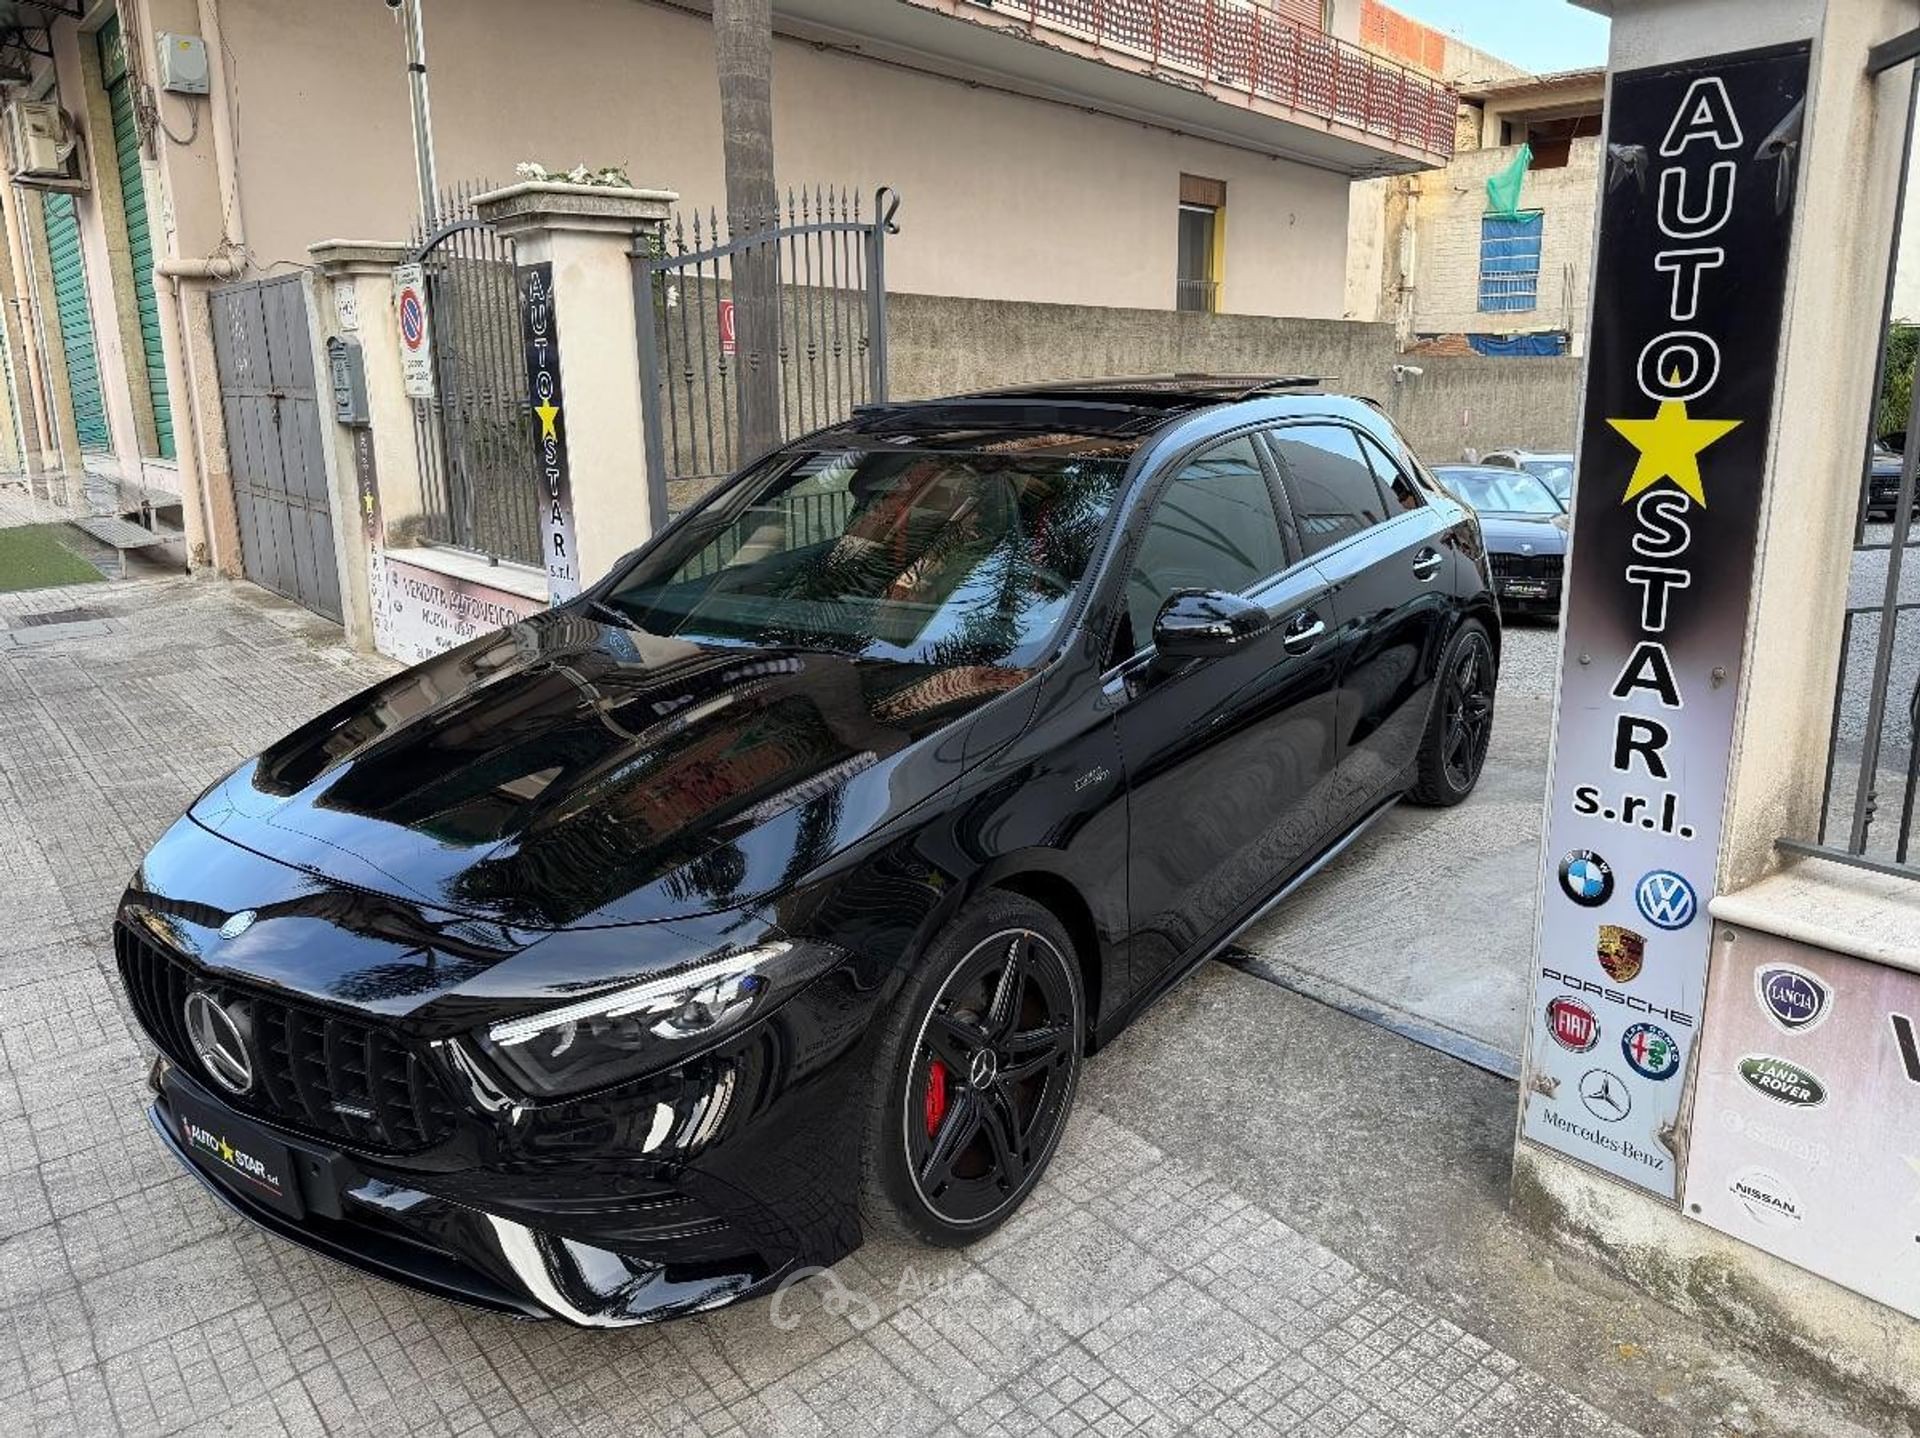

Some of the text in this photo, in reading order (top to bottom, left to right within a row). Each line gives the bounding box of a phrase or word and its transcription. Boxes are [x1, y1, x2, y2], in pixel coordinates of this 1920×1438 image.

[529, 271, 566, 557] AUTO STAR
[1610, 76, 1744, 780] AUTO STAR
[550, 564, 575, 581] s.r.l.
[1573, 785, 1697, 840] s.r.l.
[1564, 850, 1611, 875] BMW
[1542, 967, 1693, 1028] PORSCHE
[1771, 985, 1812, 1011] LANCIA
[1558, 1009, 1590, 1040] FIAT
[1624, 1024, 1680, 1063] ALFA ROMEO
[1757, 1062, 1799, 1084] LAND
[1758, 1075, 1812, 1101] ROVER
[191, 1125, 220, 1152] AUTO
[234, 1150, 266, 1179] STAR
[1542, 1108, 1664, 1171] Mercedes-Benz
[1735, 1181, 1796, 1214] NISSAN
